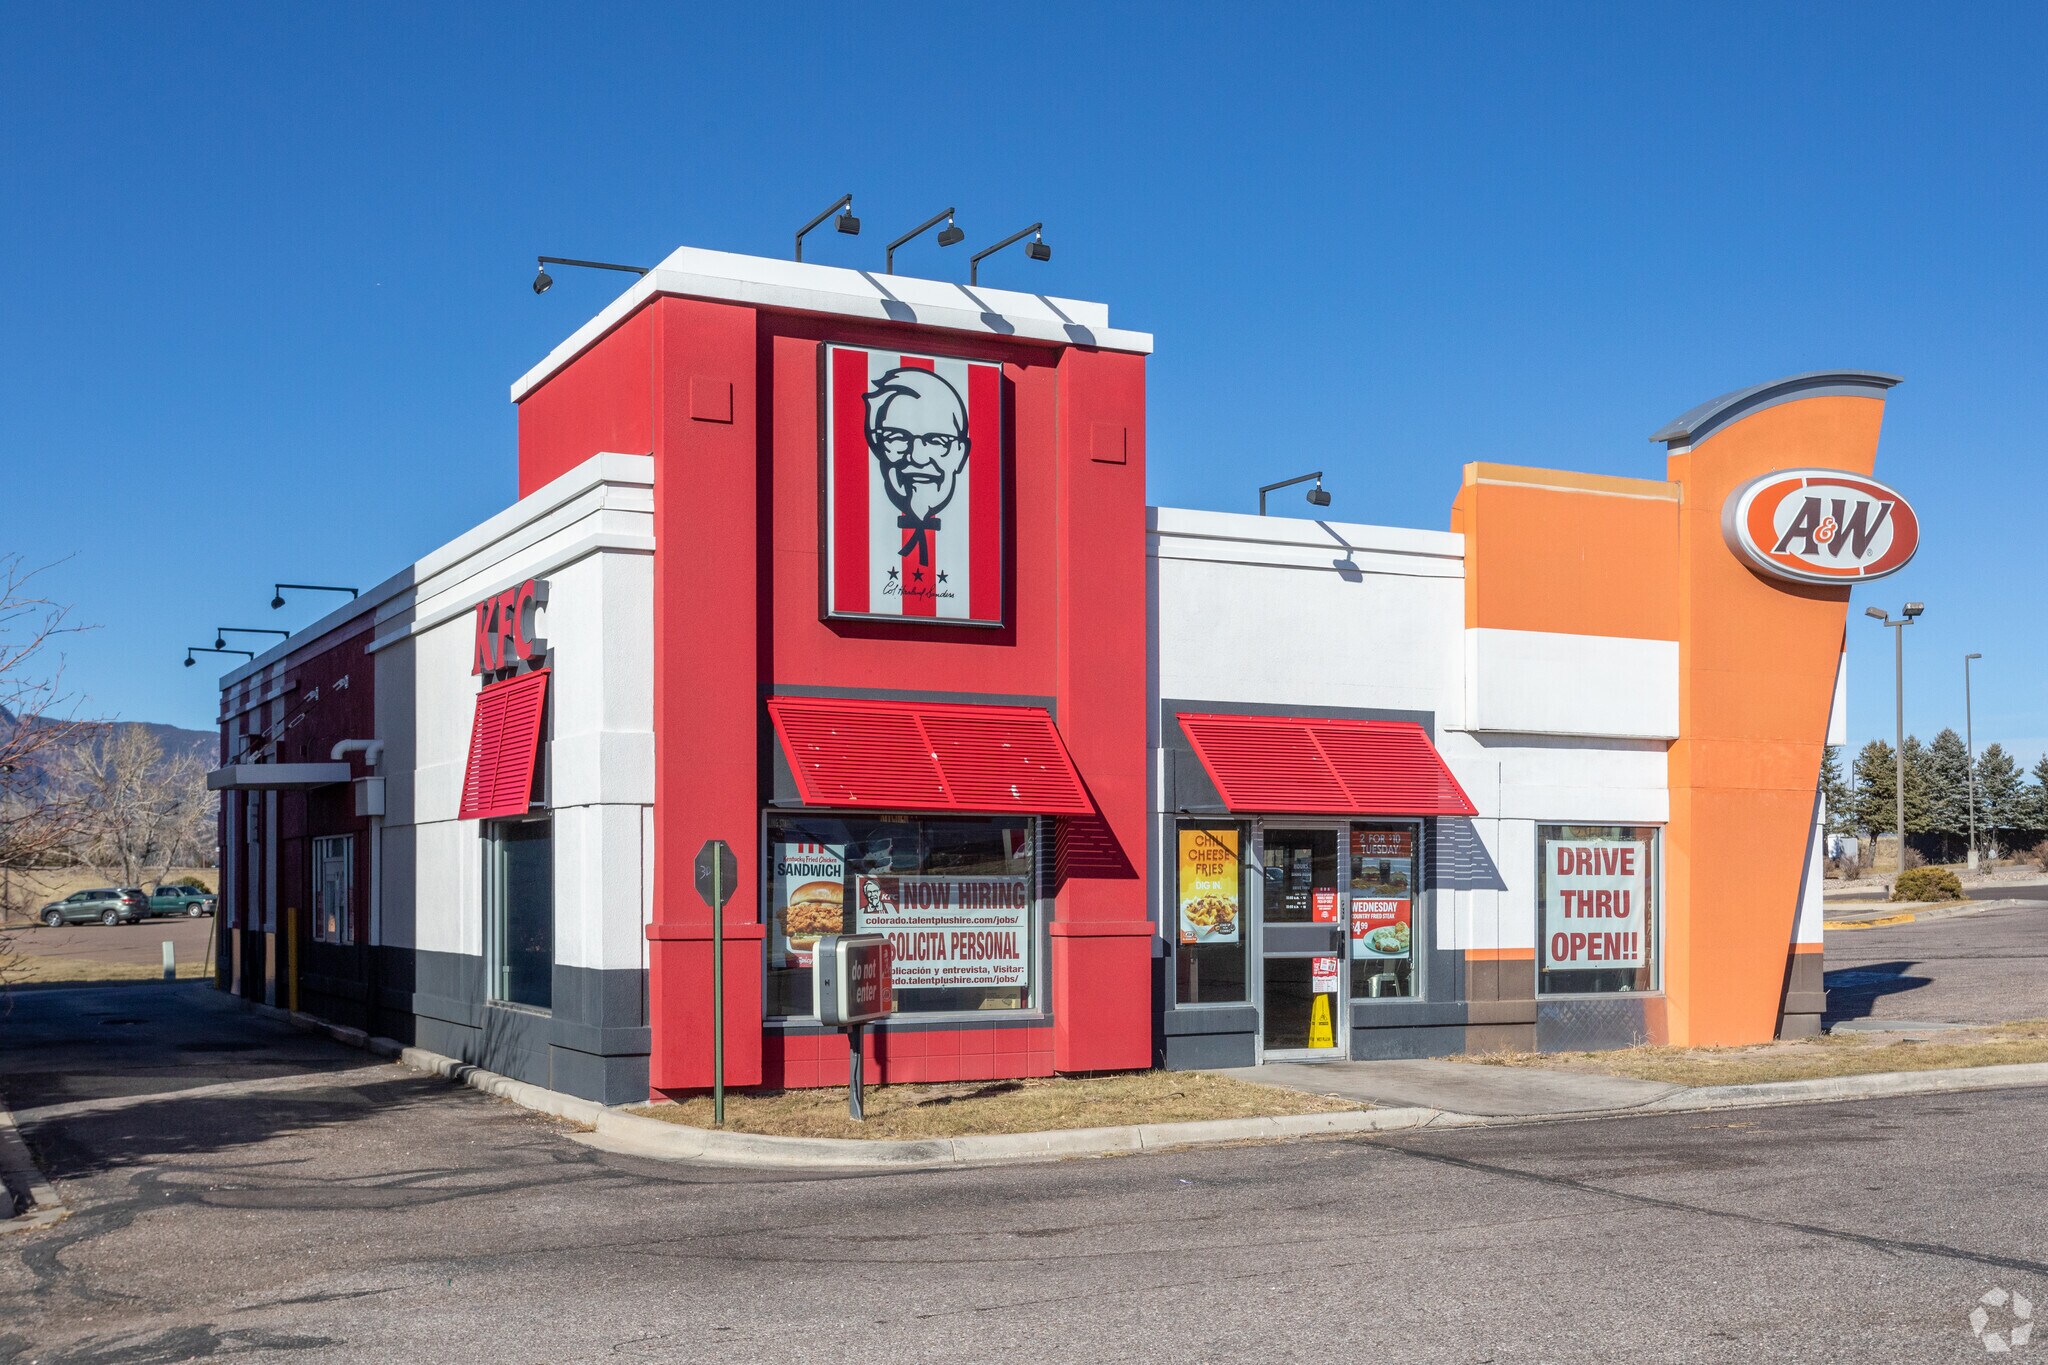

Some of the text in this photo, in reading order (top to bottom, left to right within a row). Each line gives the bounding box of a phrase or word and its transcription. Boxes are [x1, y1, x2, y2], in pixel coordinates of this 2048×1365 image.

[1774, 496, 1895, 559] A&W
[471, 578, 549, 676] KFC
[1360, 834, 1365, 843] 2
[1369, 834, 1385, 843] FOR
[1188, 849, 1230, 861] CHEESE
[1361, 844, 1399, 854] TUESDAY
[783, 855, 838, 863] Kentucky Fried Chicken
[1557, 847, 1635, 876] DRIVE
[777, 863, 841, 877] SANDWICH
[1195, 863, 1224, 877] FRIES
[1195, 881, 1210, 890] DIG
[881, 893, 899, 901] KFC
[904, 882, 1025, 910] NOW HIRING
[1352, 901, 1398, 912] WEDNESDAY
[1560, 890, 1630, 918] THRU
[866, 915, 1018, 926] colorado.talentplushire.com/jobs/
[888, 931, 1020, 961] SOLICITA PERSONAL
[1551, 932, 1638, 961] OPEN!!
[852, 959, 876, 980] do not
[934, 967, 940, 976] y
[943, 965, 990, 975] entrevista,
[993, 965, 1024, 974] Visitar:
[856, 982, 877, 1003] enter
